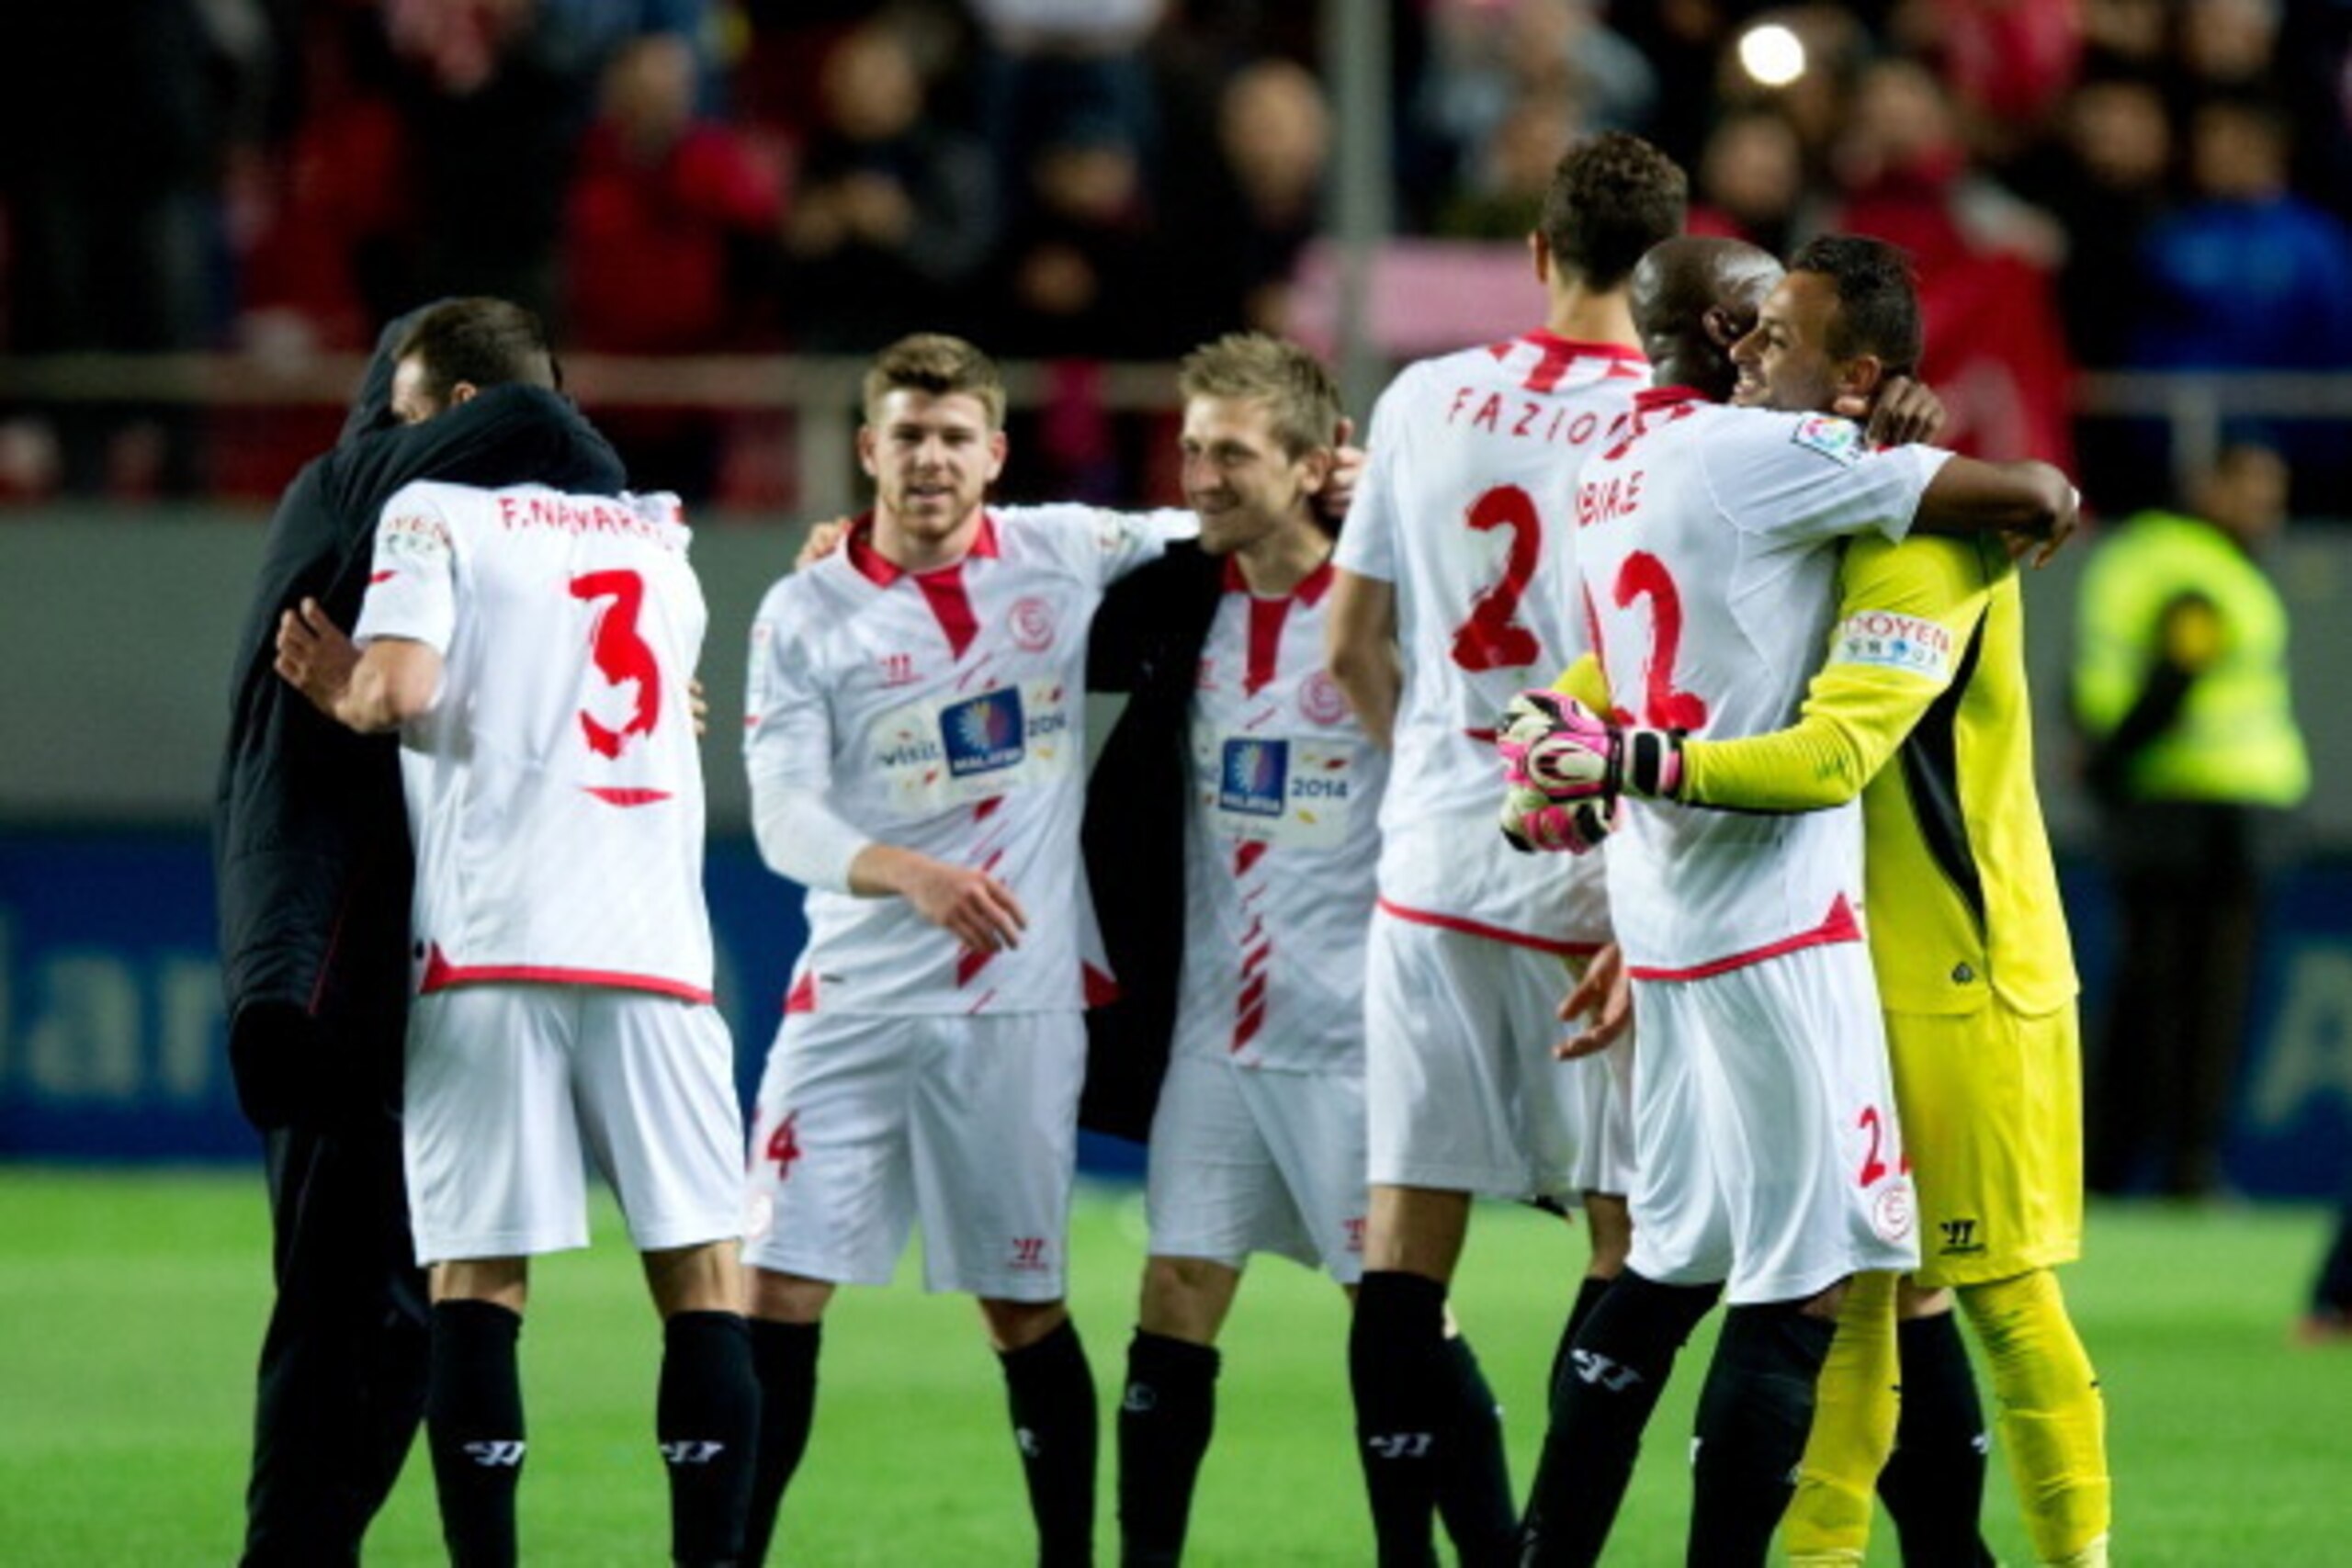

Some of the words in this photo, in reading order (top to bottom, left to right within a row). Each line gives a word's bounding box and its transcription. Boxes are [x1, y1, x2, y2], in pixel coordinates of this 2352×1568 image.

[1447, 387, 1597, 445] FAZIO
[1451, 484, 1542, 673] 2
[569, 569, 662, 761] 3
[1292, 779, 1349, 798] 2014
